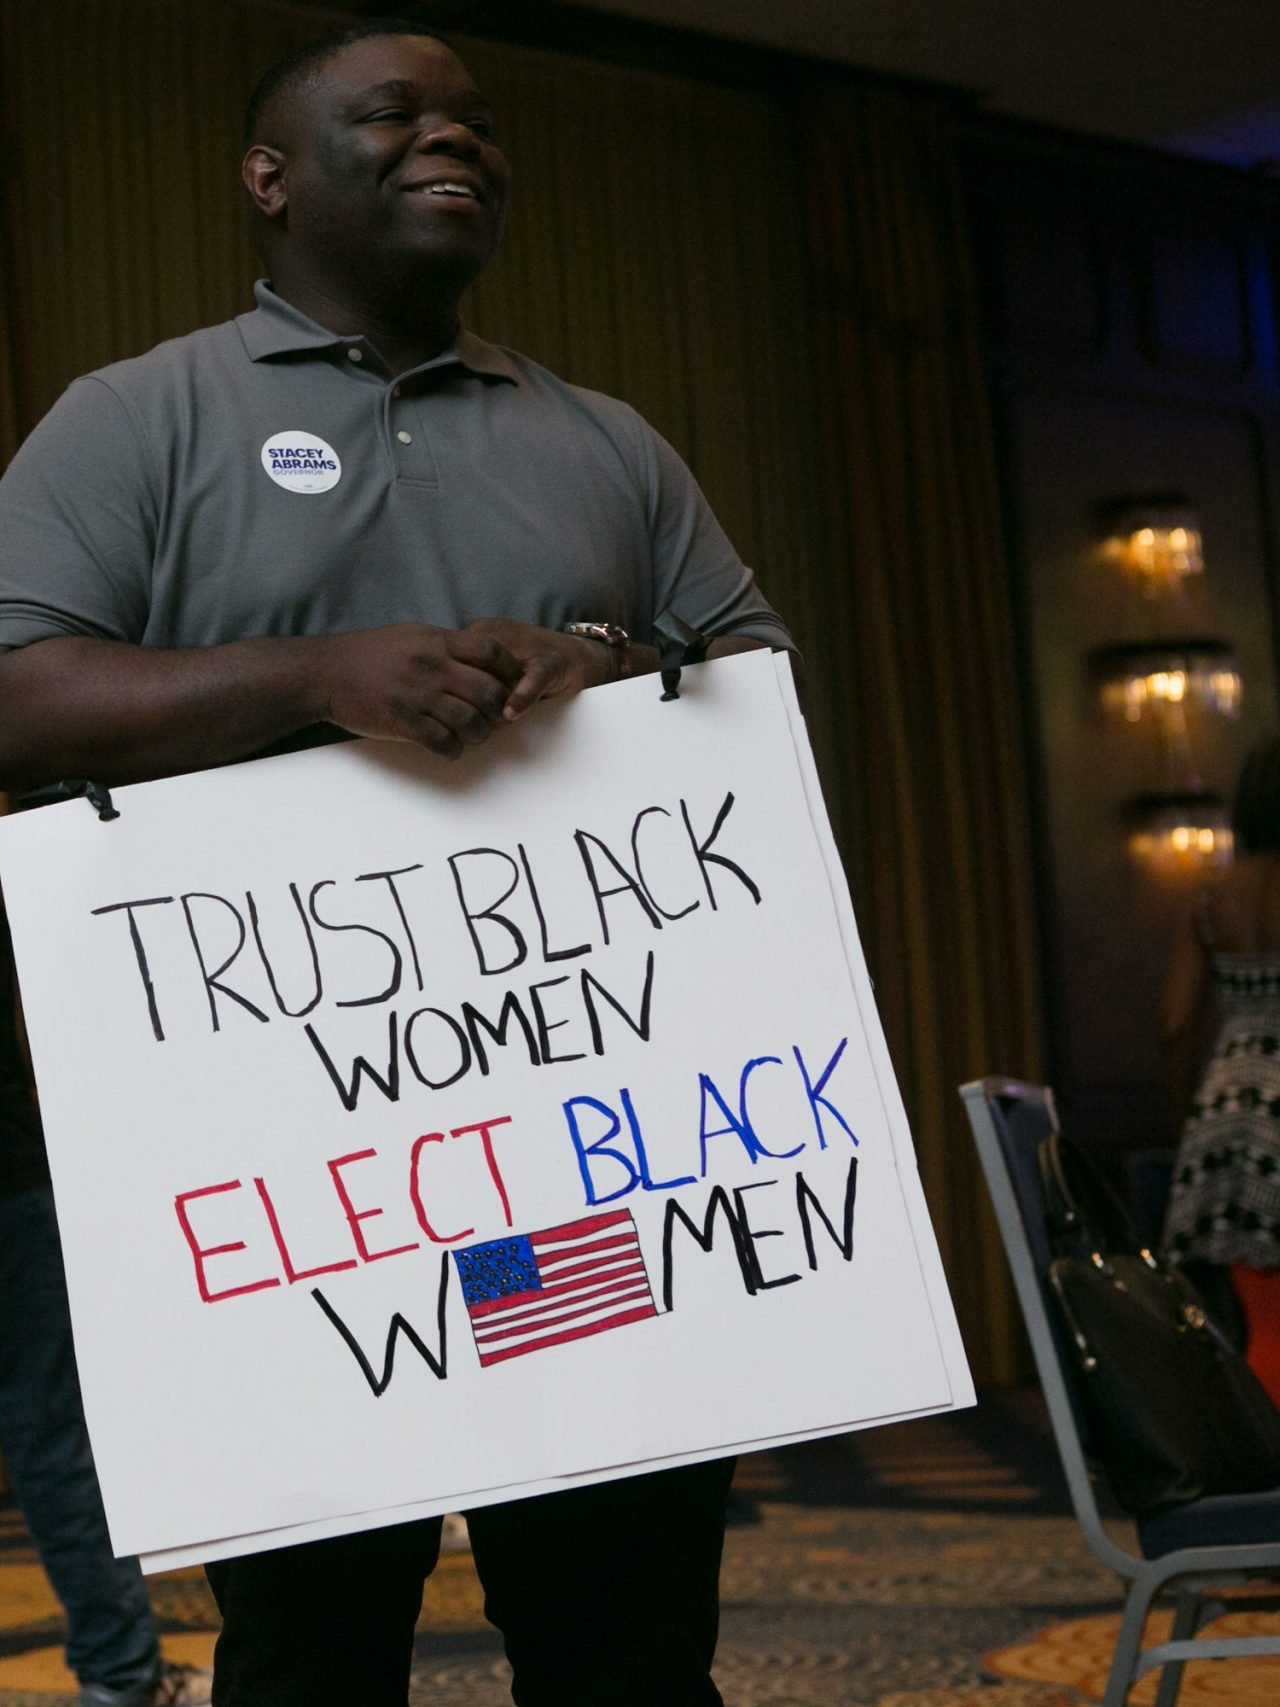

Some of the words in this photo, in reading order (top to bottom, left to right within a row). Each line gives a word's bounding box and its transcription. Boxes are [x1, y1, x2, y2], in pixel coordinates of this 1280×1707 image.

[268, 448, 323, 458] STACEY
[272, 459, 337, 470] ABRAMS
[91, 864, 424, 1042] TRUST
[447, 791, 762, 976] BLACK
[304, 950, 655, 1112] WOMEN
[173, 1115, 513, 1303] ELECT
[562, 1037, 860, 1207] BLACK
